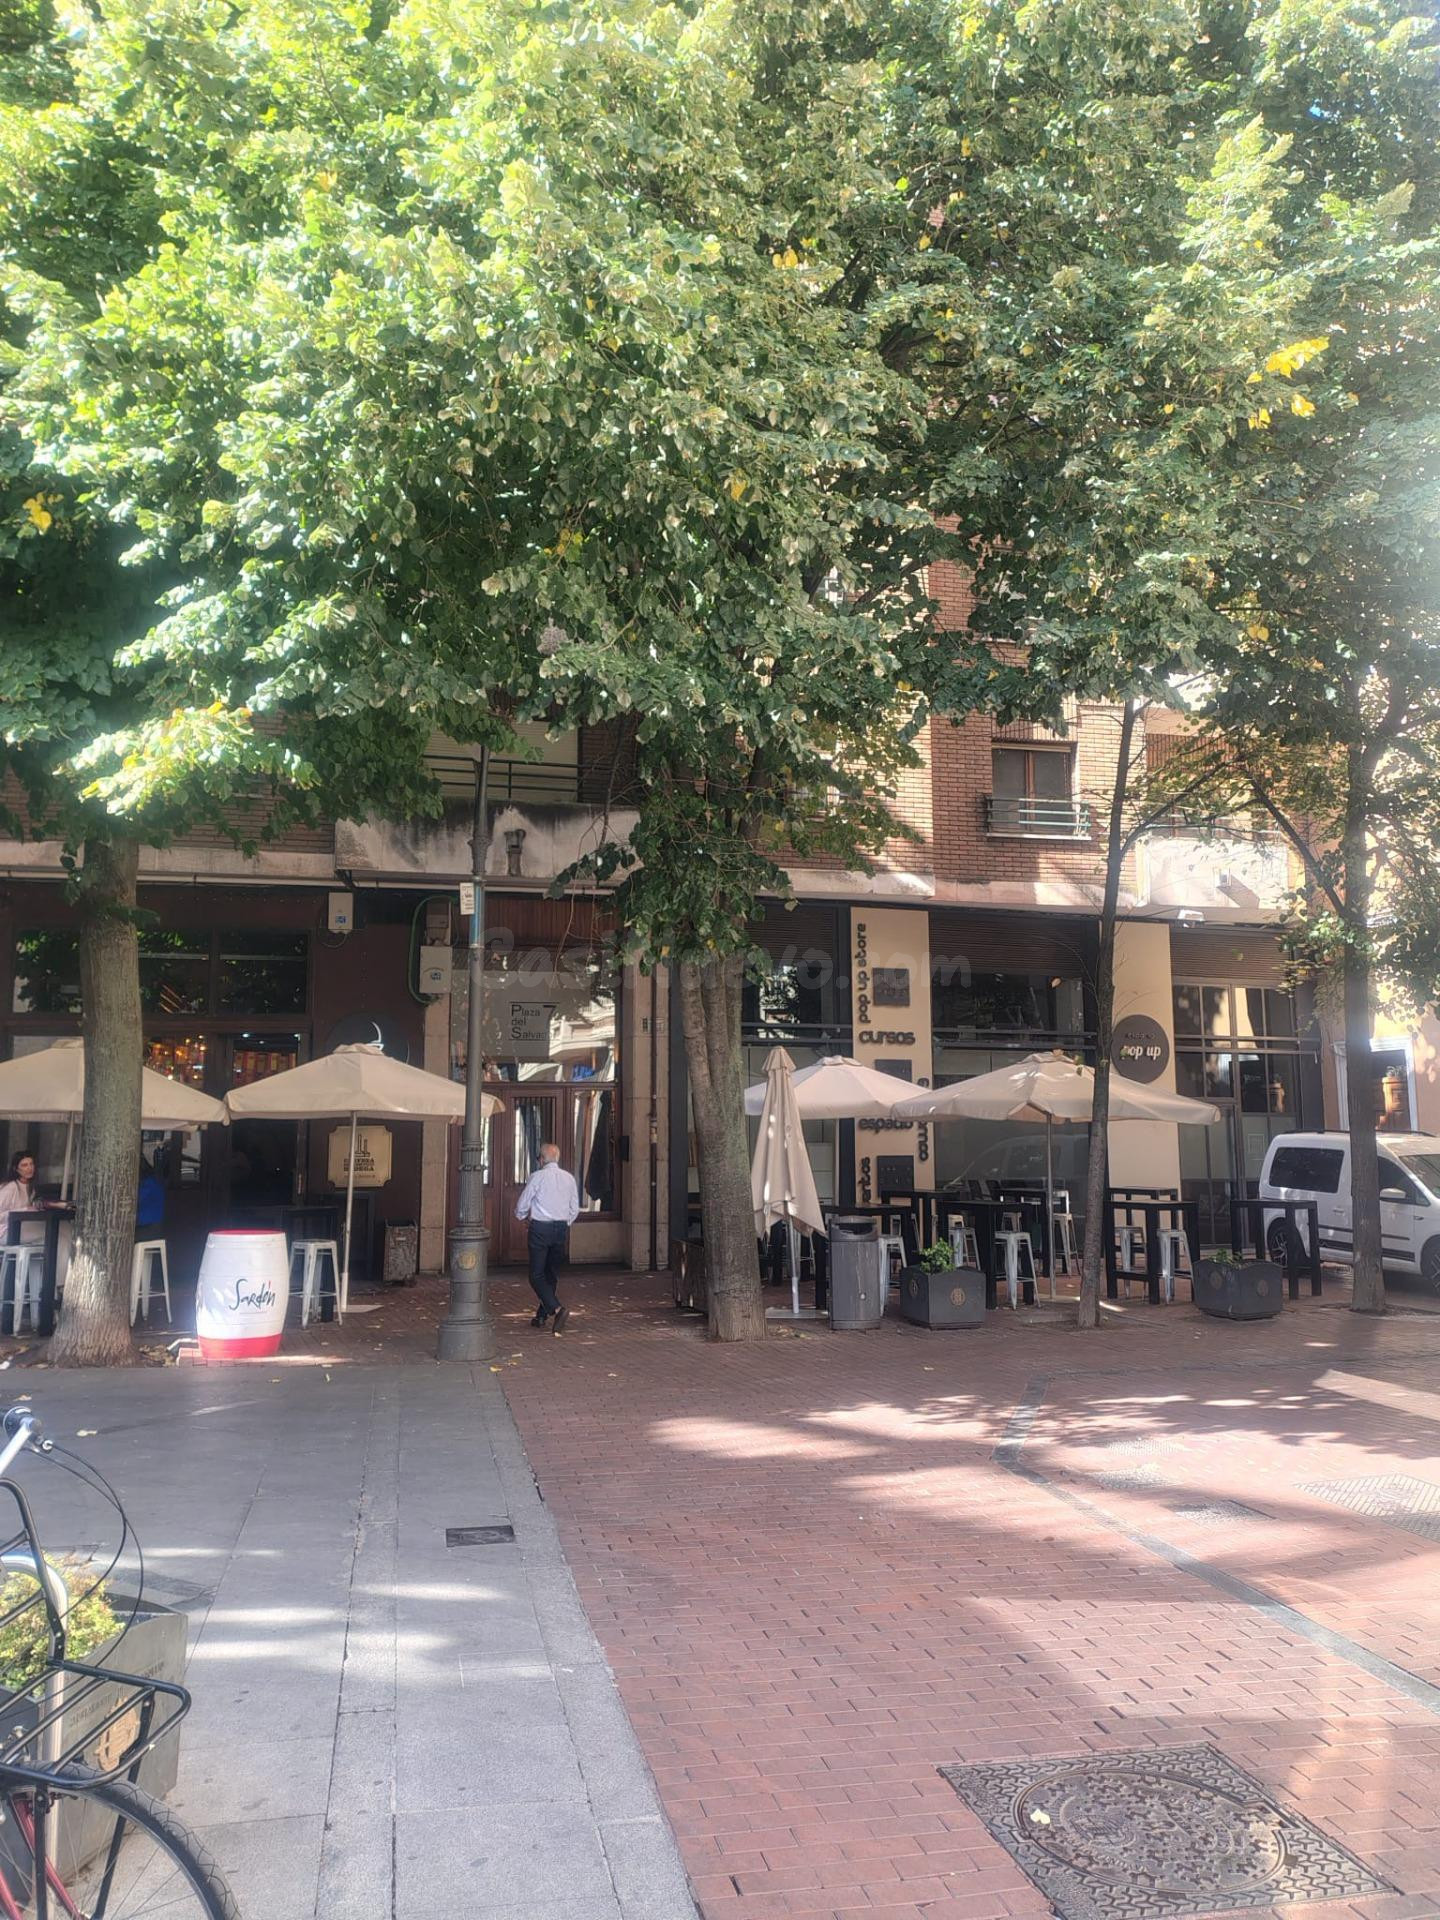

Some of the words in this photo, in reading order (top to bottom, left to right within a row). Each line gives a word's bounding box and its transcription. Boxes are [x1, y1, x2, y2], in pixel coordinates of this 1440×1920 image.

[855, 923, 867, 968] store
[858, 970, 870, 991] up
[512, 1004, 540, 1016] Plaza
[859, 993, 871, 1024] pop
[512, 1017, 526, 1025] del
[859, 1030, 916, 1046] cursos
[1146, 1045, 1162, 1060] up
